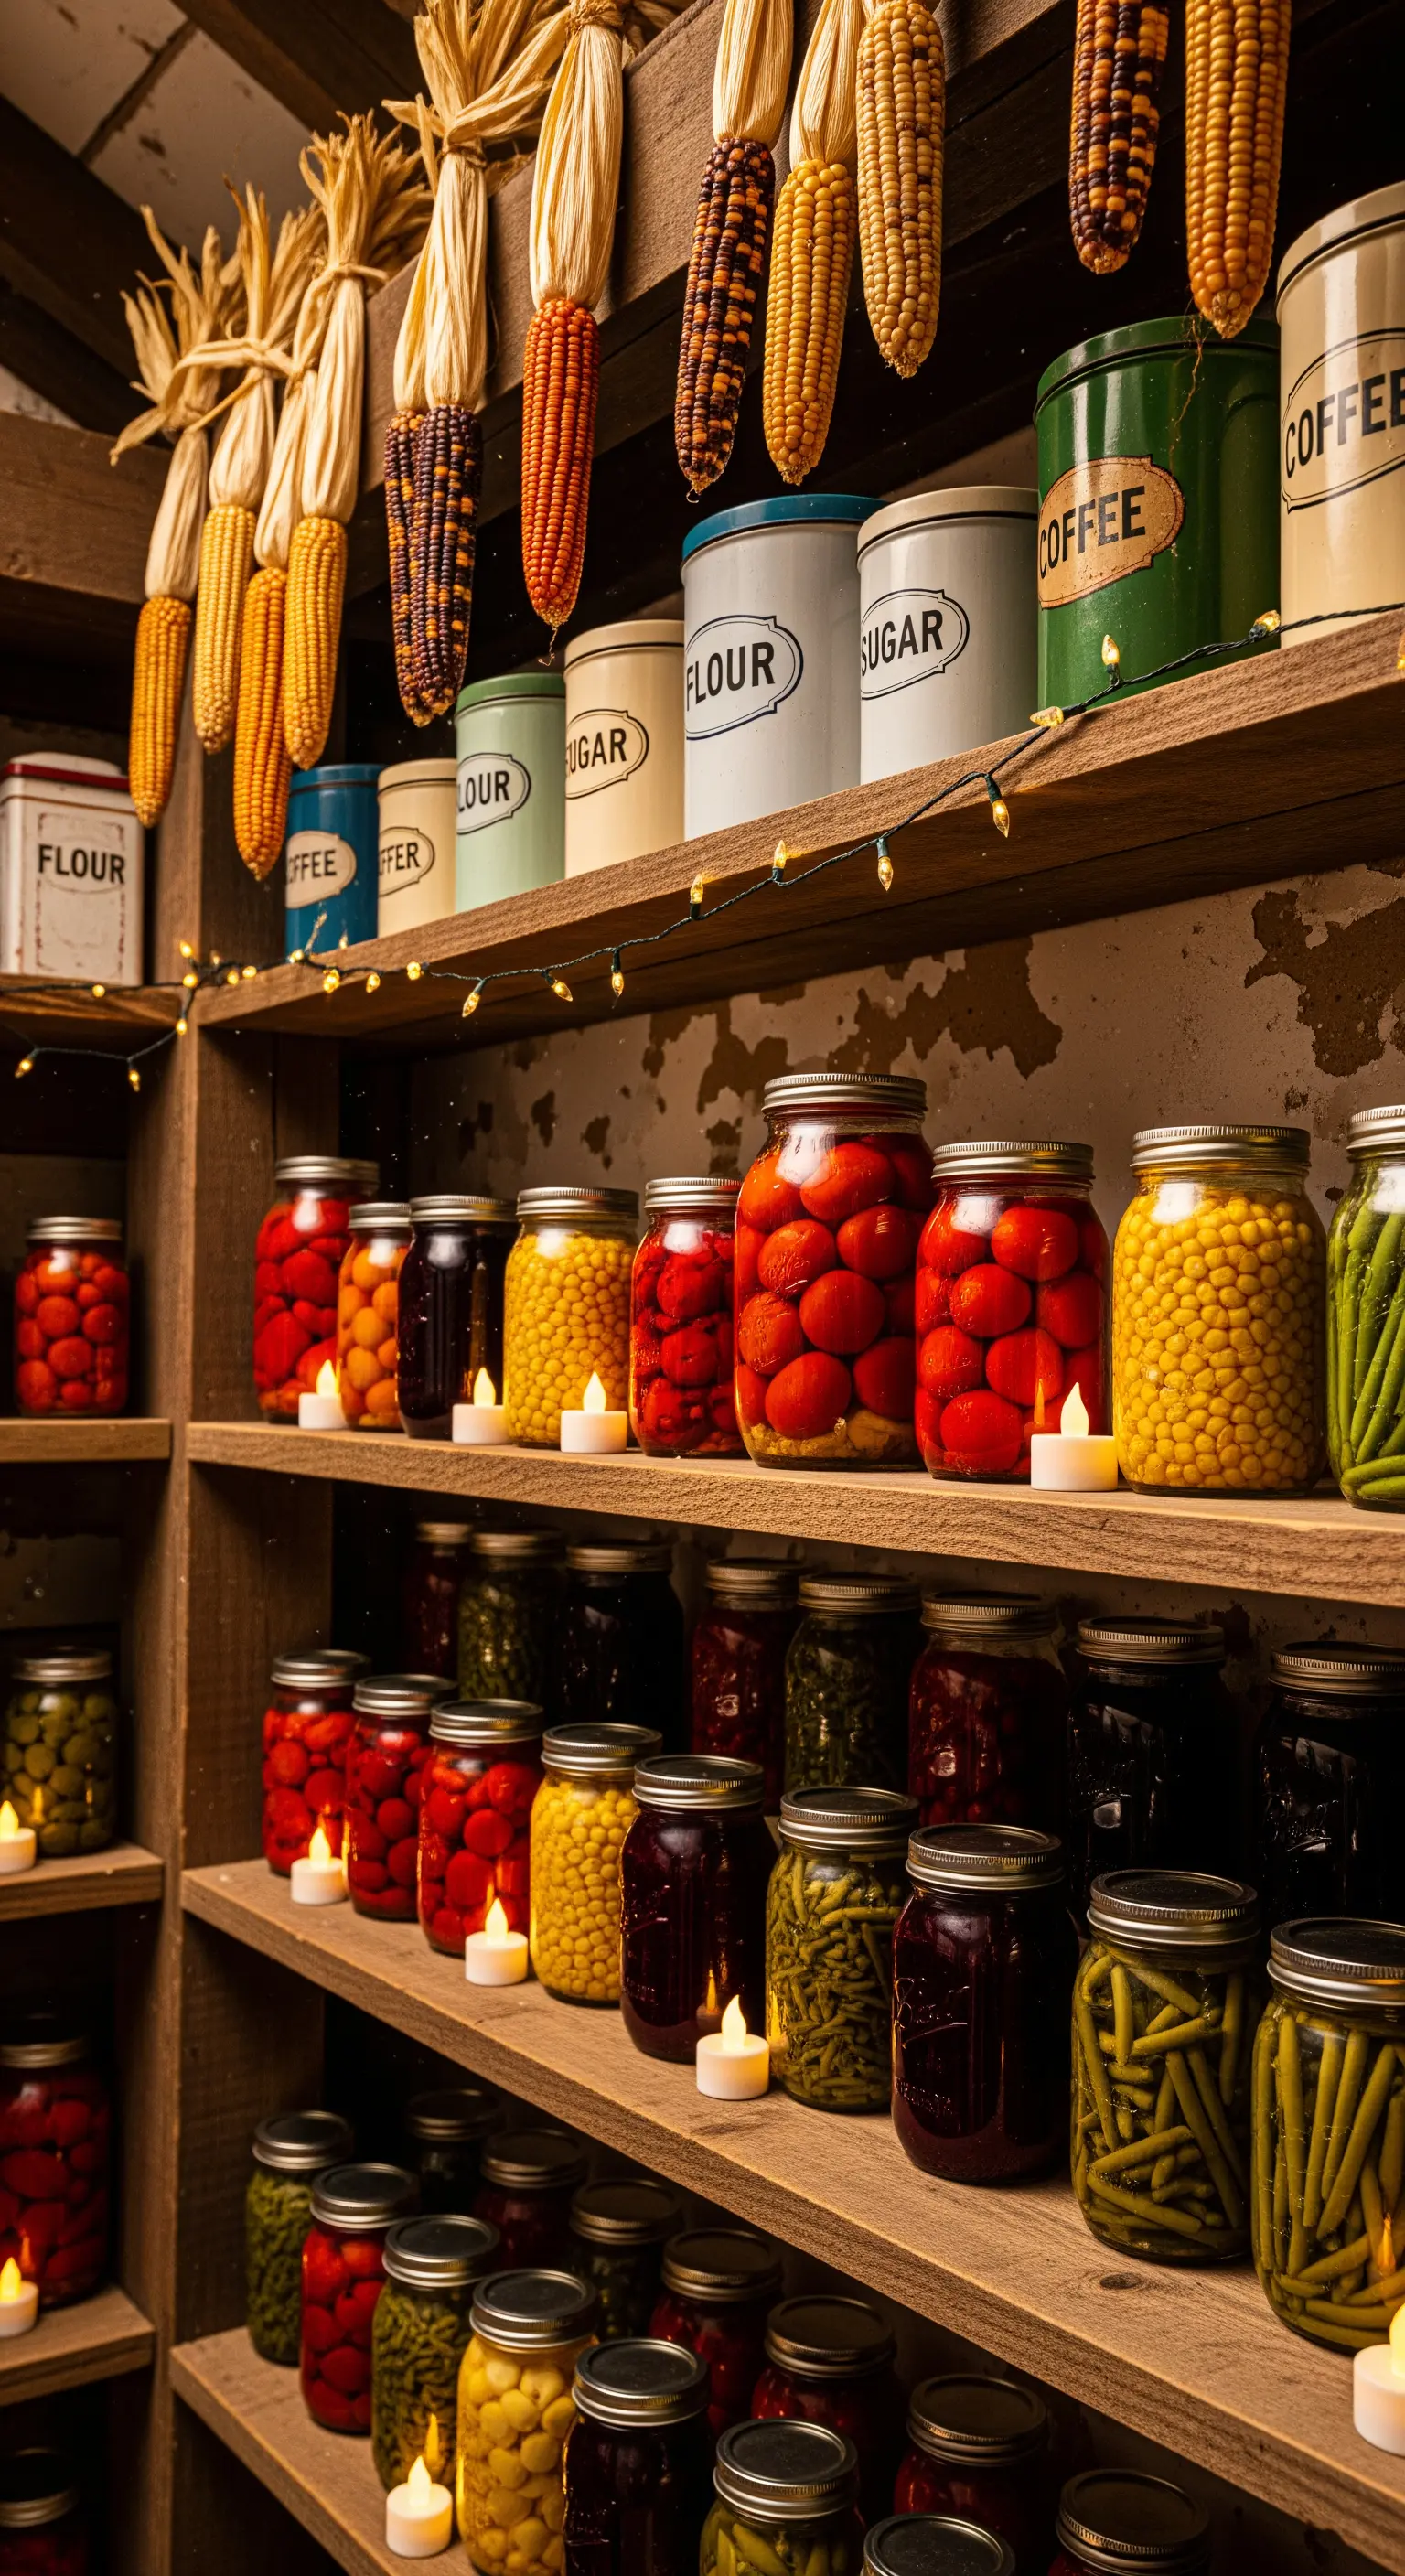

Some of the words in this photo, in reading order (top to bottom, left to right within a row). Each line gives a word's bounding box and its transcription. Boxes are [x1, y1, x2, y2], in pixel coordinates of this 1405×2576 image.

[1039, 485, 1145, 579] COFFEE
[687, 641, 775, 711] FLOUR
[862, 609, 943, 677] SUGAR
[565, 727, 627, 773] UGAR
[38, 843, 125, 885] FLOUR
